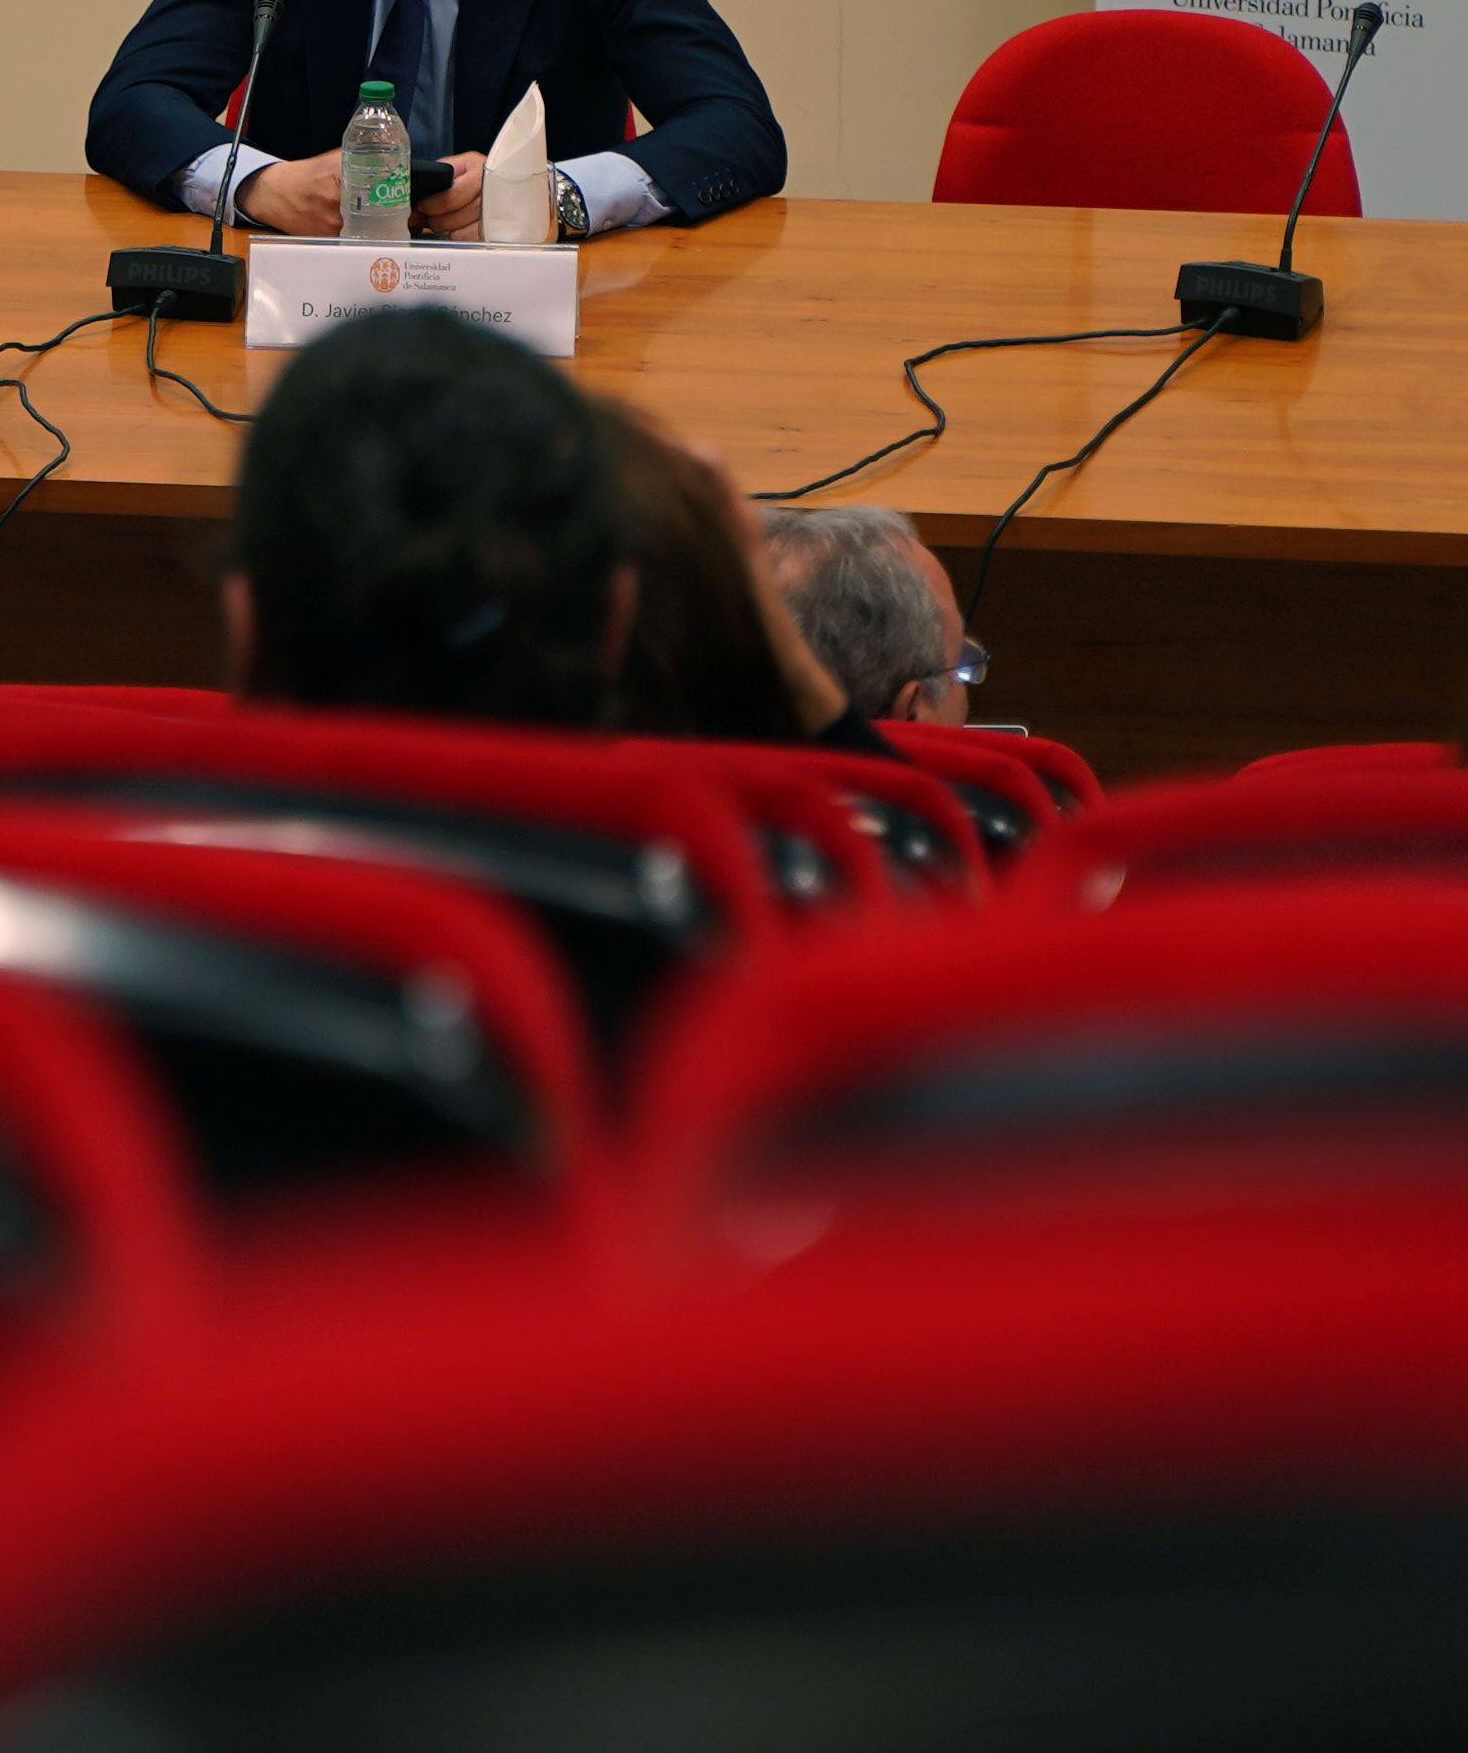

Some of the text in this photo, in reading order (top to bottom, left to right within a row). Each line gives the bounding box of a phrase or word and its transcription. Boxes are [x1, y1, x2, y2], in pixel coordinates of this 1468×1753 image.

[127, 261, 212, 285] PHILIPS
[1194, 275, 1278, 303] PHILIPS
[301, 302, 319, 318] D.
